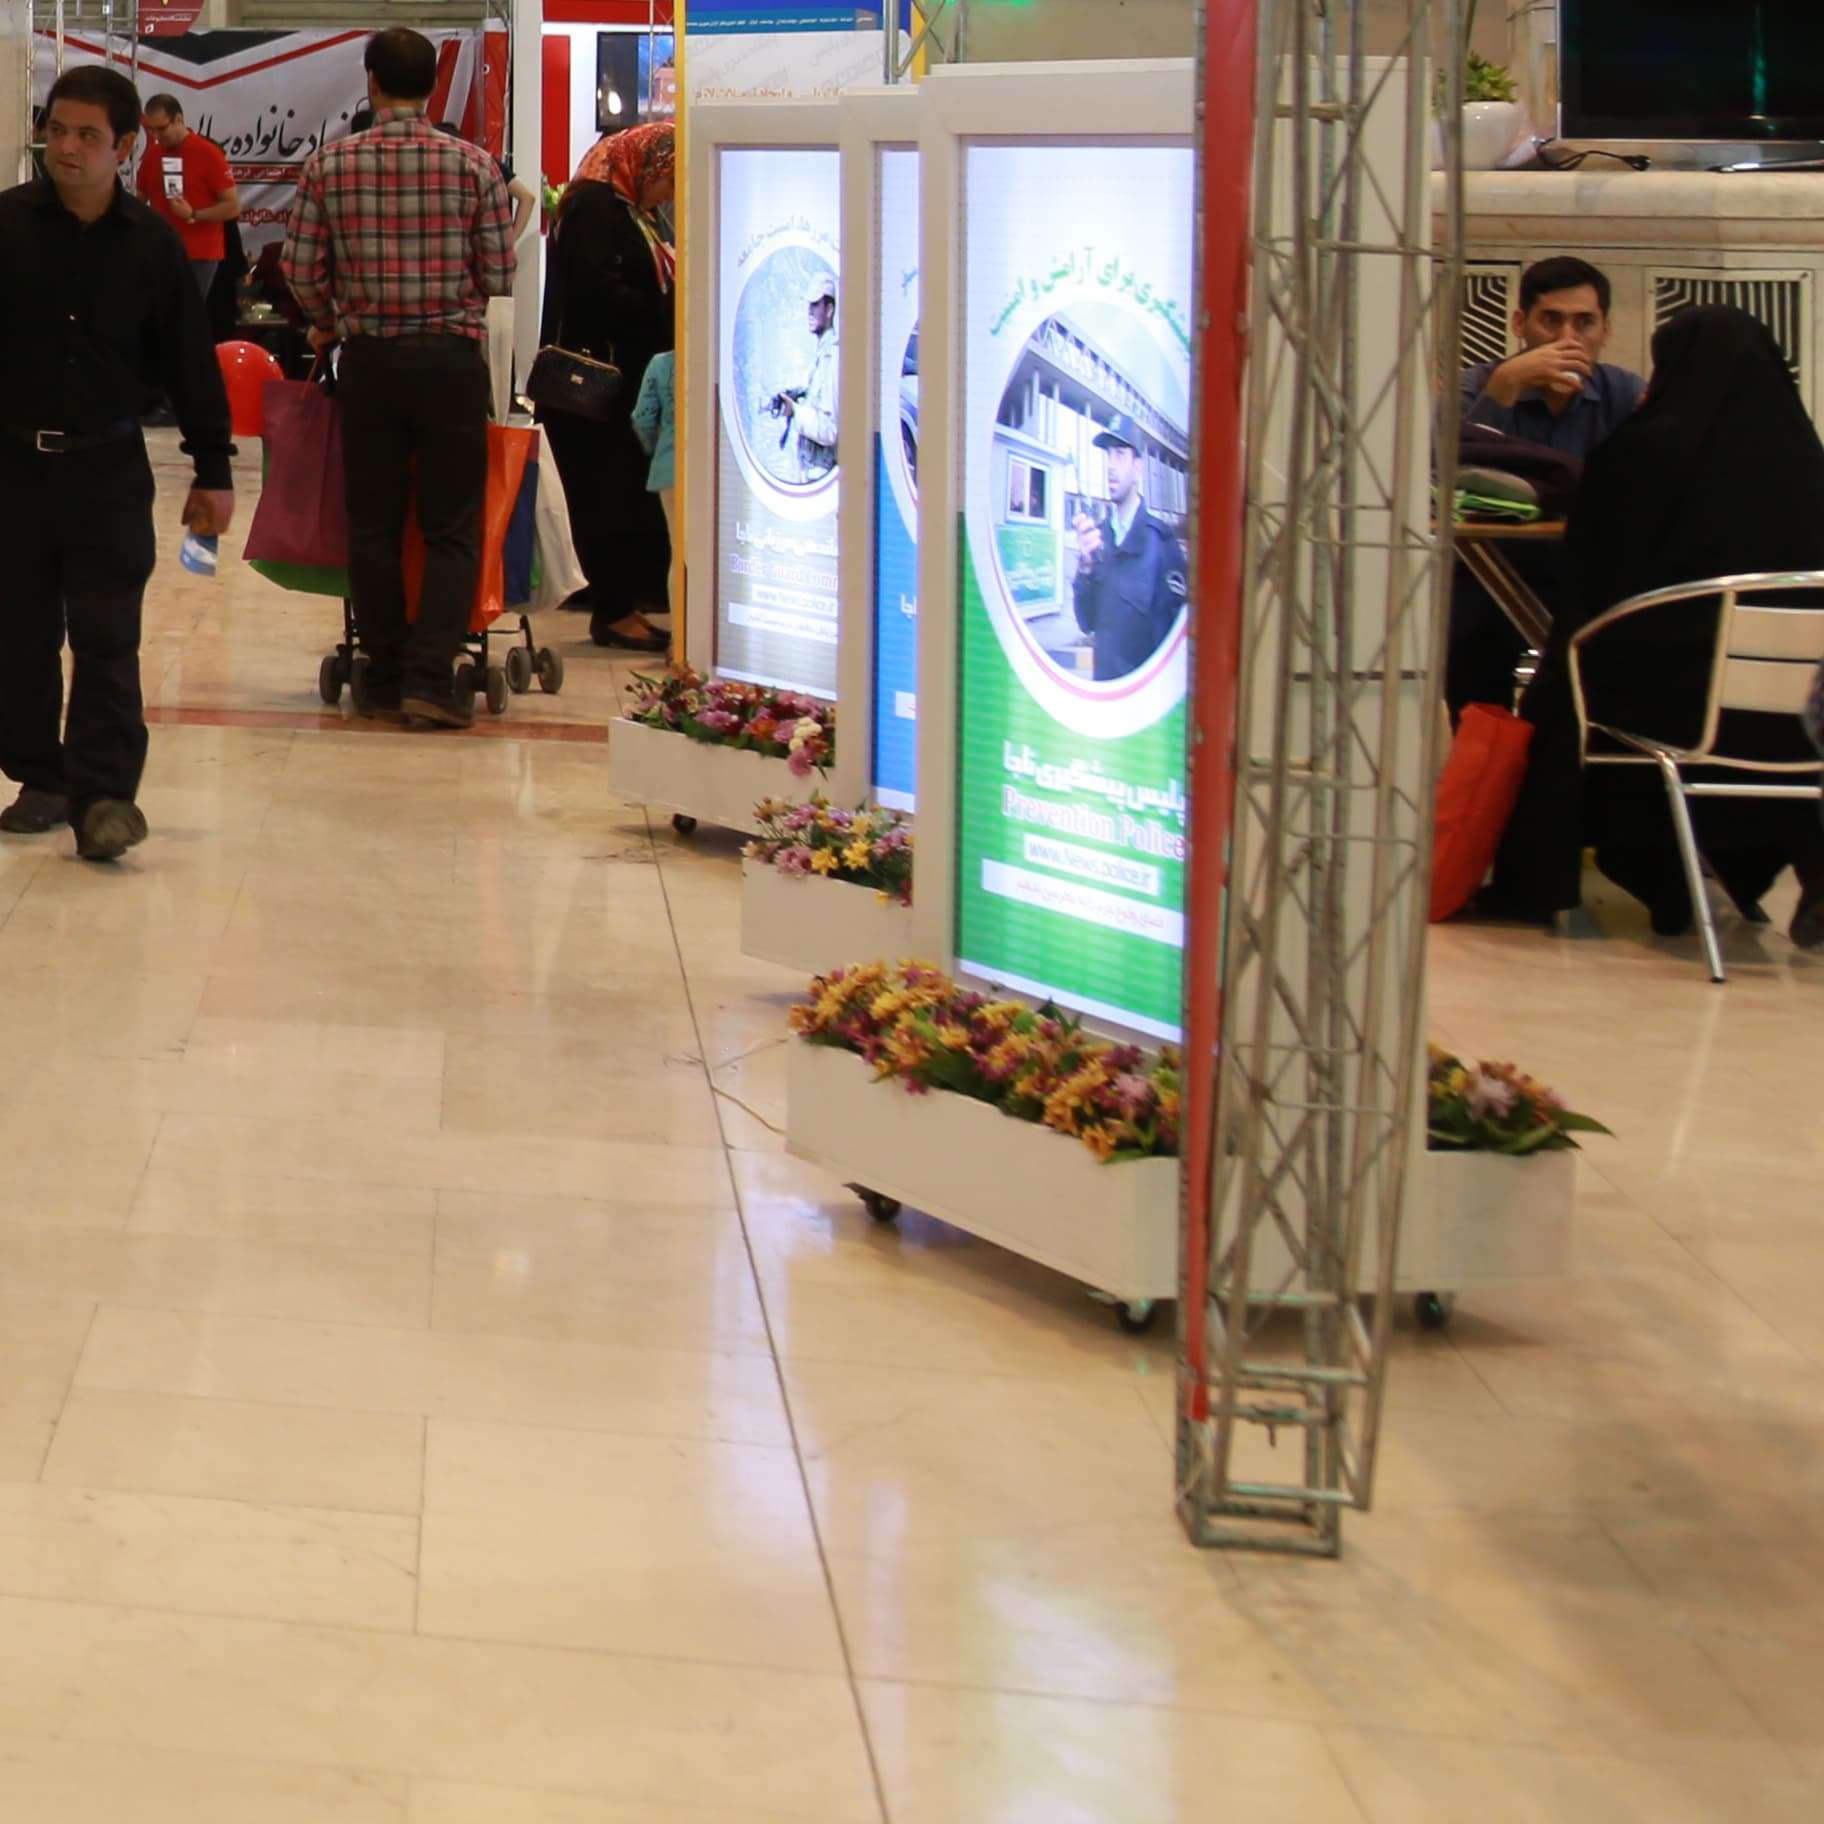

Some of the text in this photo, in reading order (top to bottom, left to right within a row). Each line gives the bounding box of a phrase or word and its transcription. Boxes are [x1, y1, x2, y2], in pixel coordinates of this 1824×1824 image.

[230, 105, 305, 157] خانواده
[1003, 783, 1186, 862] Prevention Police
